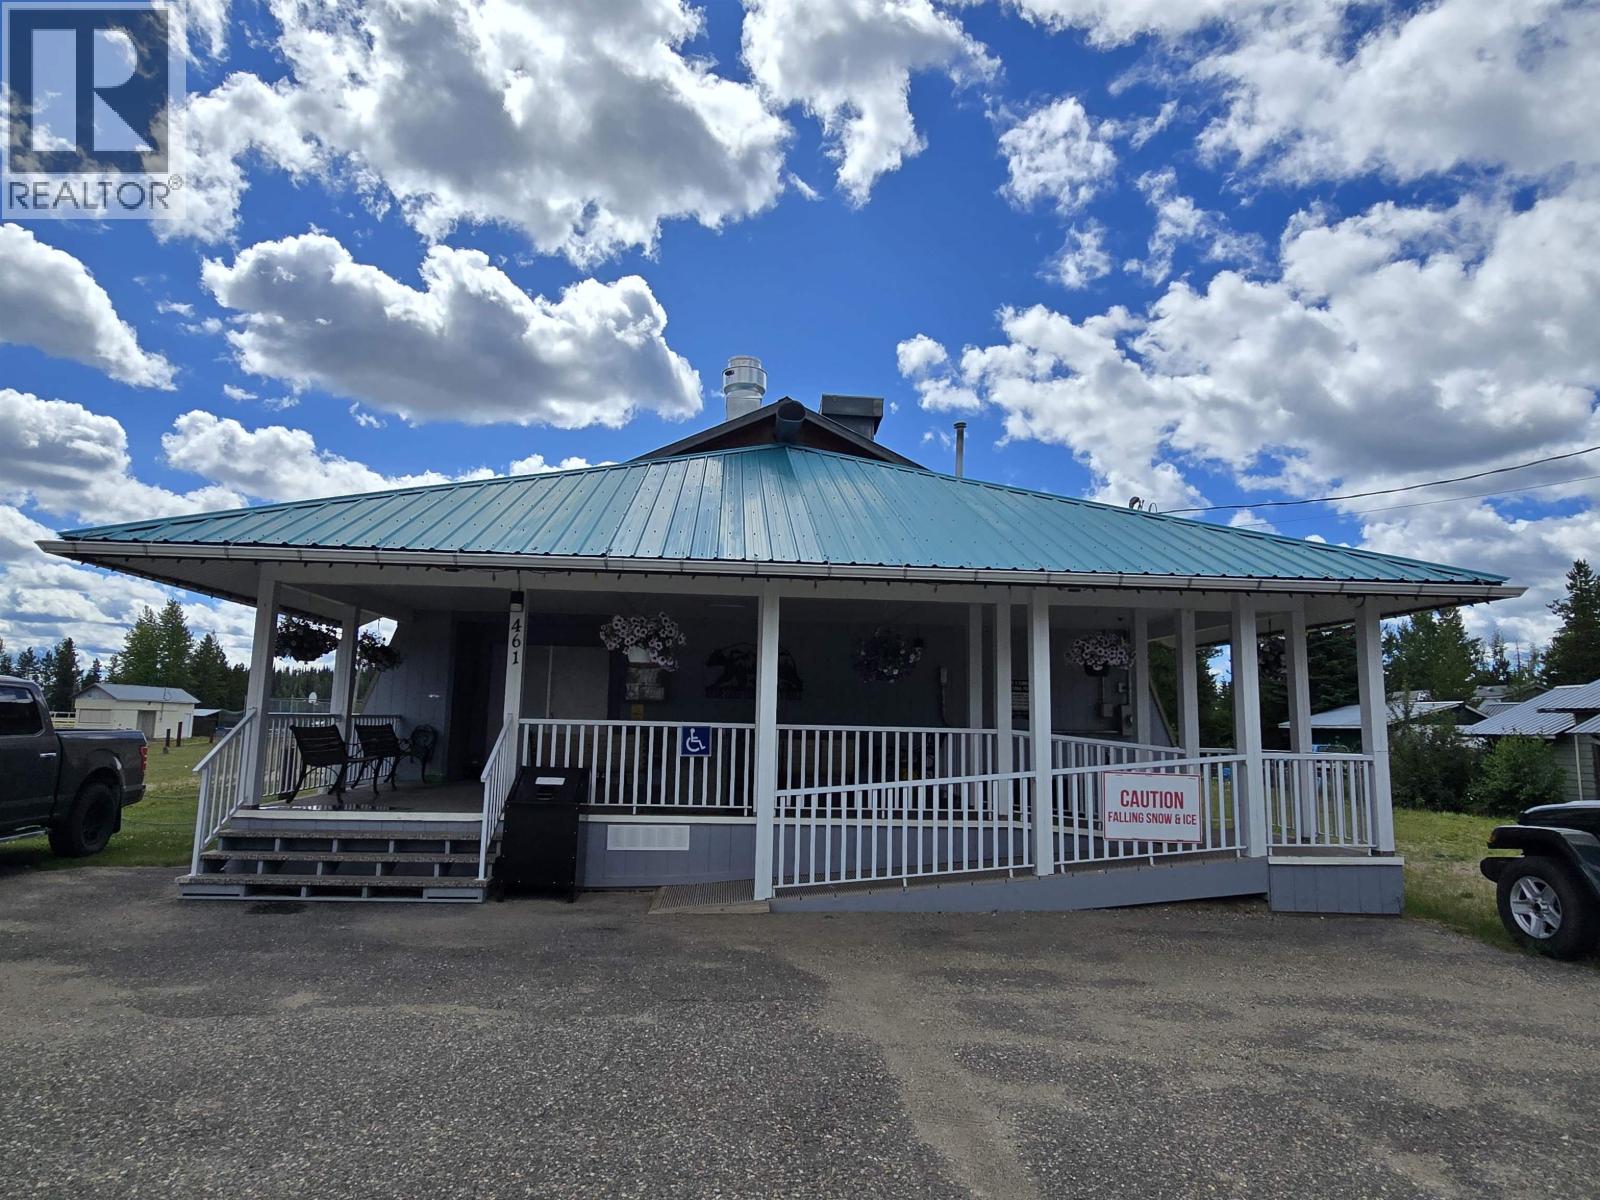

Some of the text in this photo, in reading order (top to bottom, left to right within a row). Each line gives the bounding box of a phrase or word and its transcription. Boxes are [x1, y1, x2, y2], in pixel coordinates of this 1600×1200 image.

[511, 618, 522, 665] 461
[1120, 789, 1184, 809] CAUTION
[1107, 811, 1197, 826] FALLING SNOW & ICE
